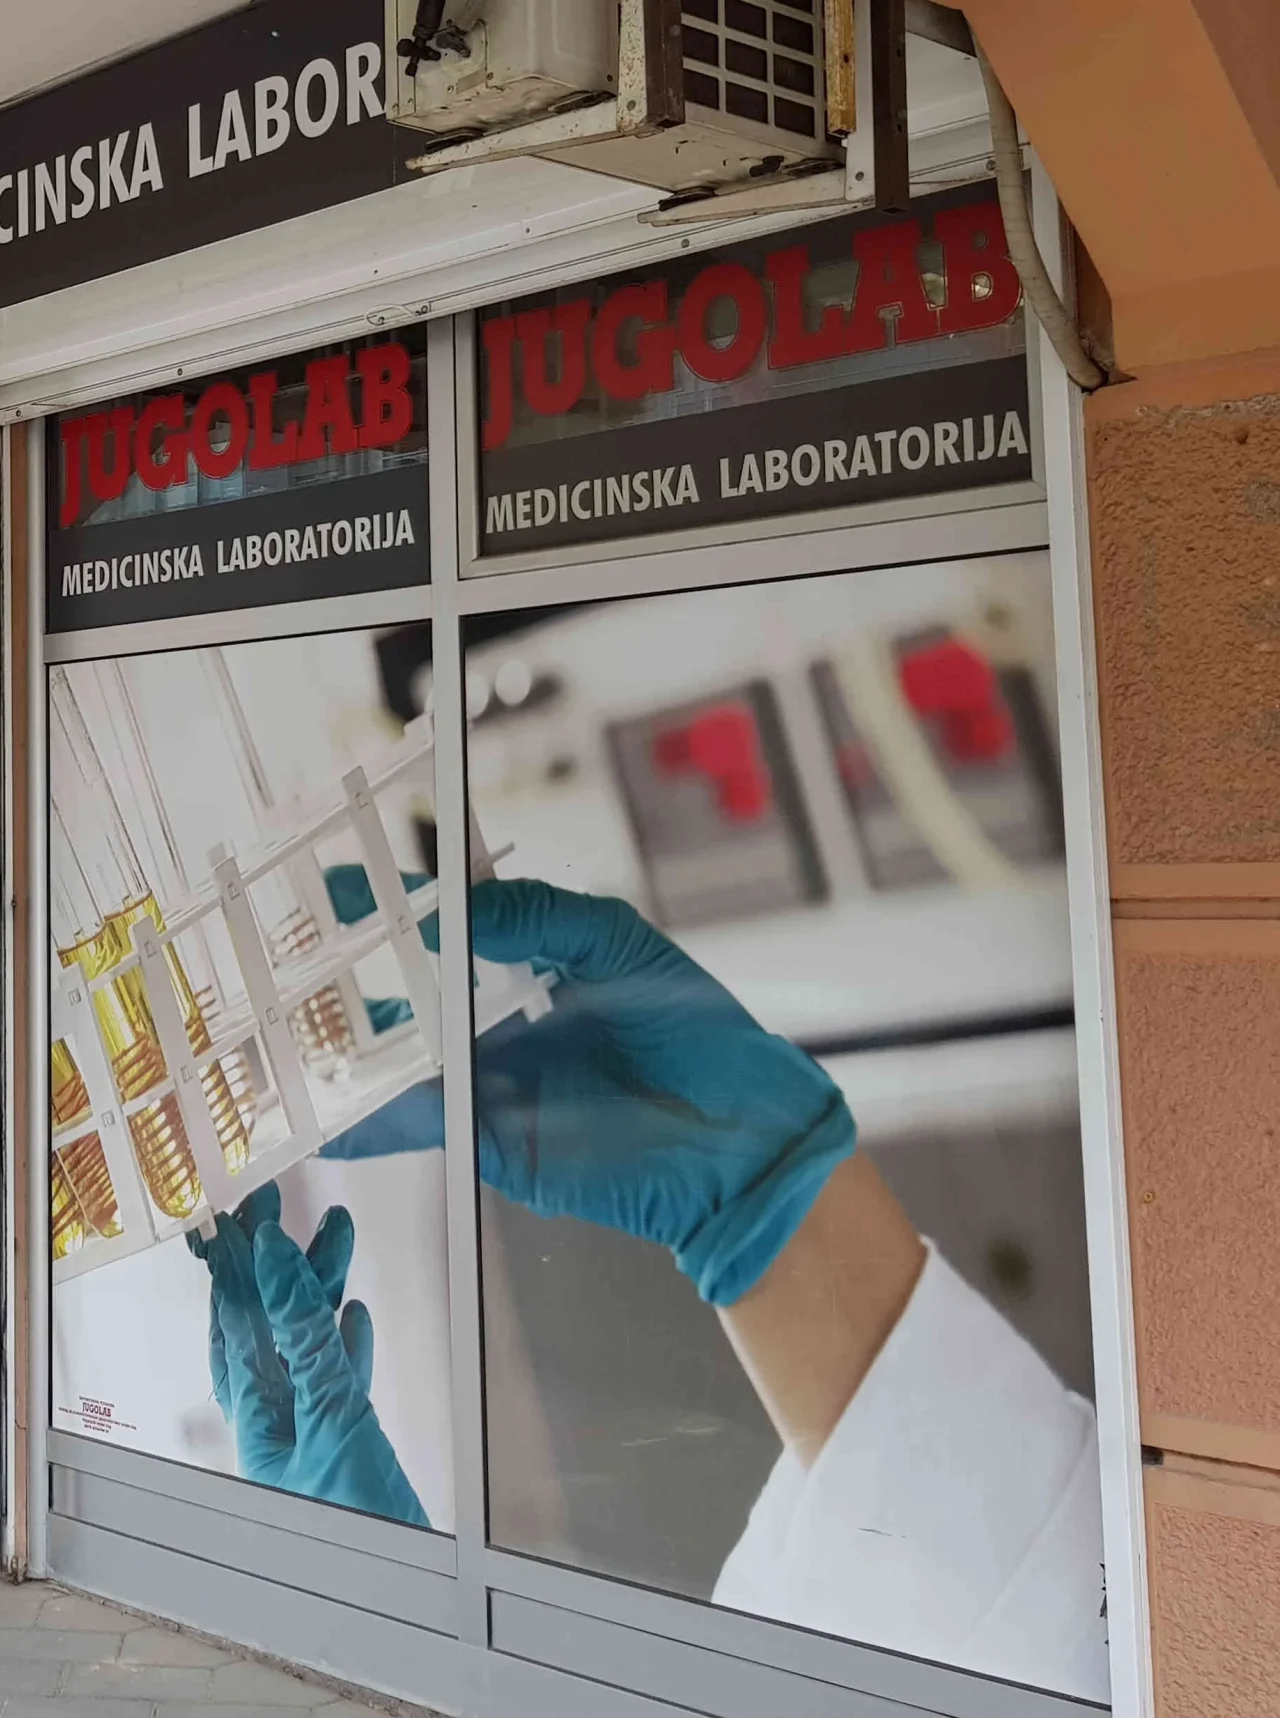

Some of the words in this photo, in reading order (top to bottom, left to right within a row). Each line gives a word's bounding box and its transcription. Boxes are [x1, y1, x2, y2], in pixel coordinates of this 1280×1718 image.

[482, 204, 1022, 451] JUGOLAB
[60, 342, 414, 529] JUGOLAB
[485, 464, 700, 534] MEDICINSKA
[720, 410, 1028, 499] LABORATORIJA
[61, 544, 204, 598] MEDICINSKA
[217, 509, 415, 575] LABORATORIJA
[82, 1402, 112, 1417] JUGOLAB
